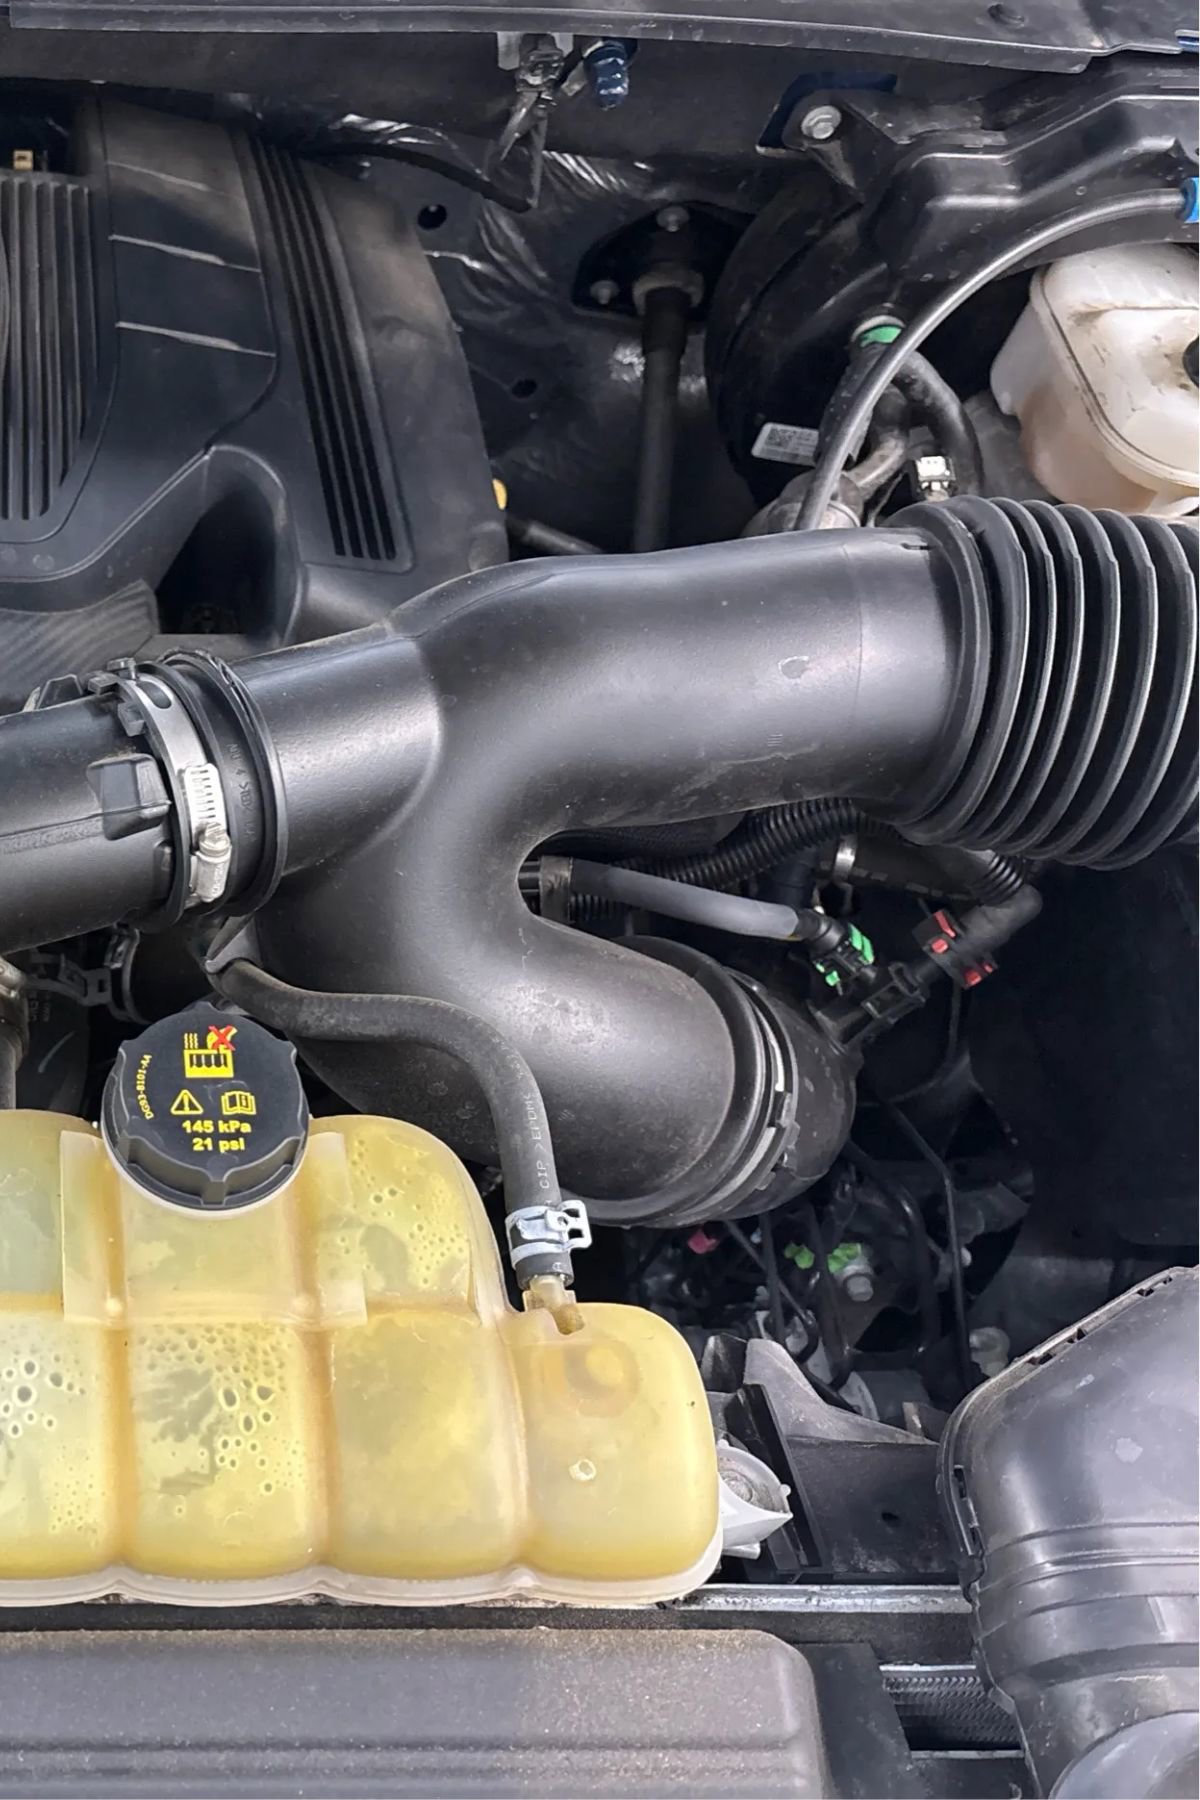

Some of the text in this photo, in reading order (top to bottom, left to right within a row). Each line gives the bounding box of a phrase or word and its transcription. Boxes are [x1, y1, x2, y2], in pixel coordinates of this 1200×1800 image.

[182, 1120, 252, 1134] 145 kPa
[192, 1137, 246, 1154] 21 psi
